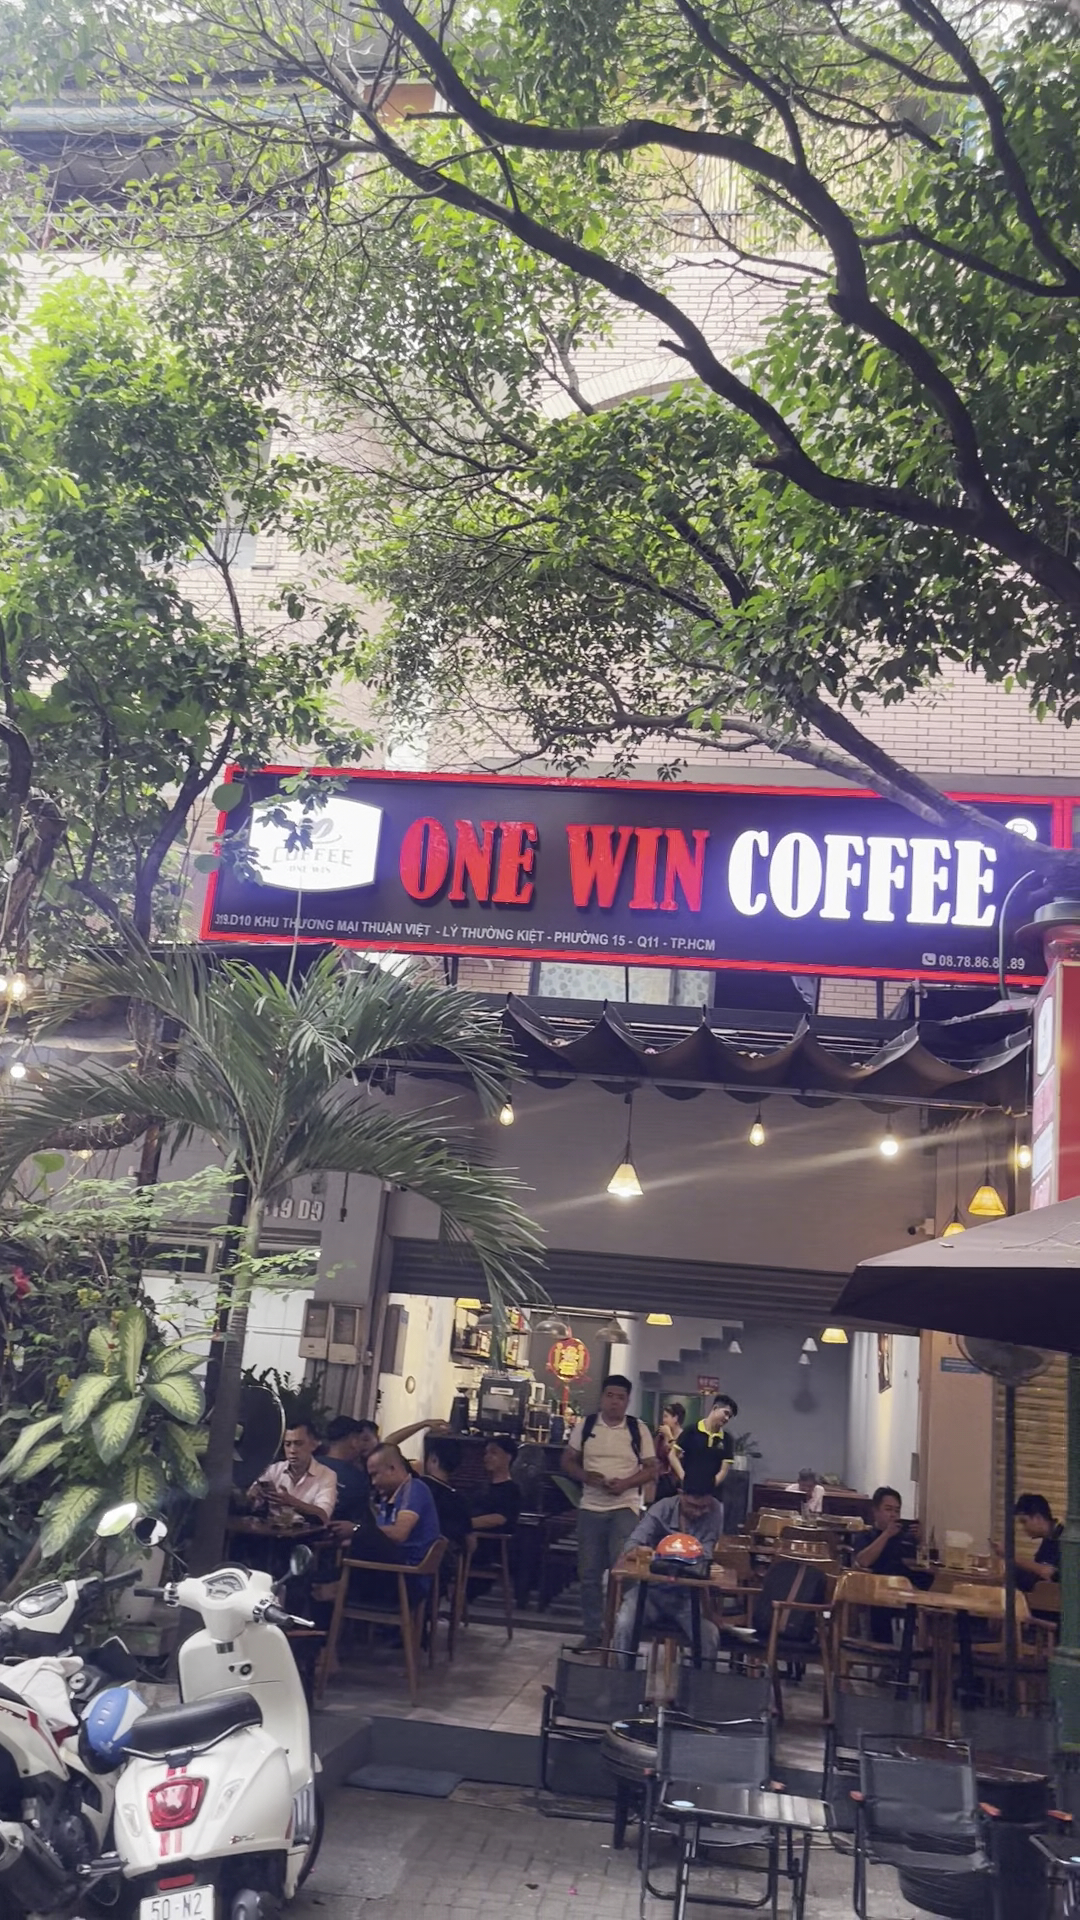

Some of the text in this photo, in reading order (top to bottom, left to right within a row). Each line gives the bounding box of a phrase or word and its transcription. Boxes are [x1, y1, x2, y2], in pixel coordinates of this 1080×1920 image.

[399, 816, 997, 927] ONE WIN COFFEE
[254, 915, 279, 928] KHU
[337, 920, 359, 934] MẠI
[404, 922, 431, 937] VIỆT
[442, 923, 458, 937] LÝ
[516, 928, 545, 944] KIỆT
[554, 930, 609, 946] PHƯỜNG
[612, 935, 626, 946] 15
[637, 936, 659, 948] Q11
[670, 937, 716, 951] TP.HCM
[939, 954, 1025, 970] 08.78.86.8.89
[264, 1198, 323, 1222] 19 D9
